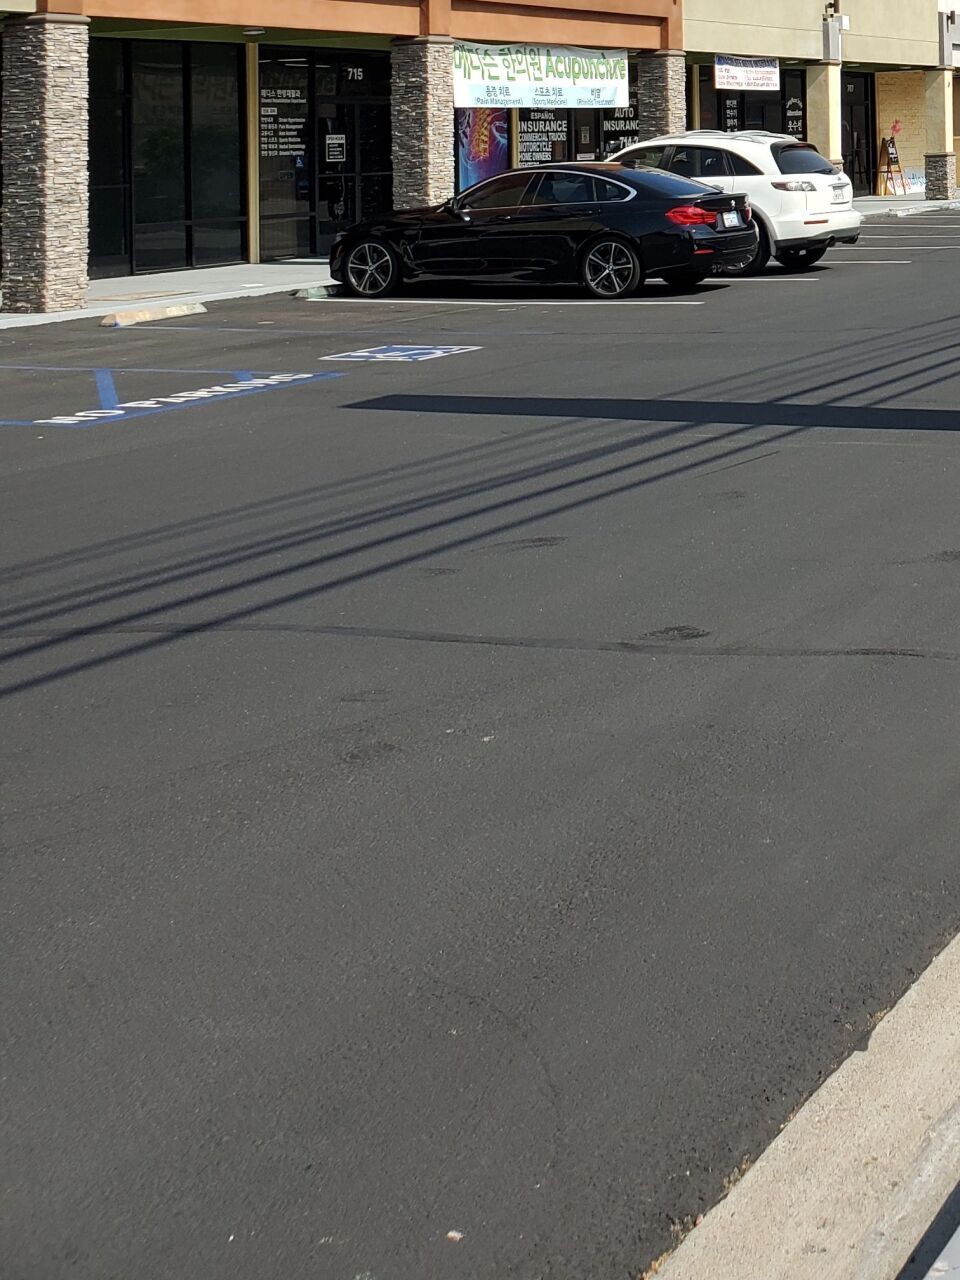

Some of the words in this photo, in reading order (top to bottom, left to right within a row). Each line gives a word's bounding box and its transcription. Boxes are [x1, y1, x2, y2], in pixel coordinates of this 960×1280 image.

[499, 47, 543, 82] 한의원
[545, 49, 627, 86] Acupuncture
[347, 67, 363, 80] 715
[530, 111, 555, 120] ESPAÑOL
[615, 107, 634, 118] AUTO
[519, 120, 567, 132] INSURANCE
[603, 120, 640, 131] INSURANC
[519, 132, 548, 142] COMMERCIAL
[548, 132, 567, 141] TRUCKS
[519, 141, 552, 152] MOTORCYCLE
[33, 409, 126, 424] NO
[116, 373, 313, 408] PARKING
